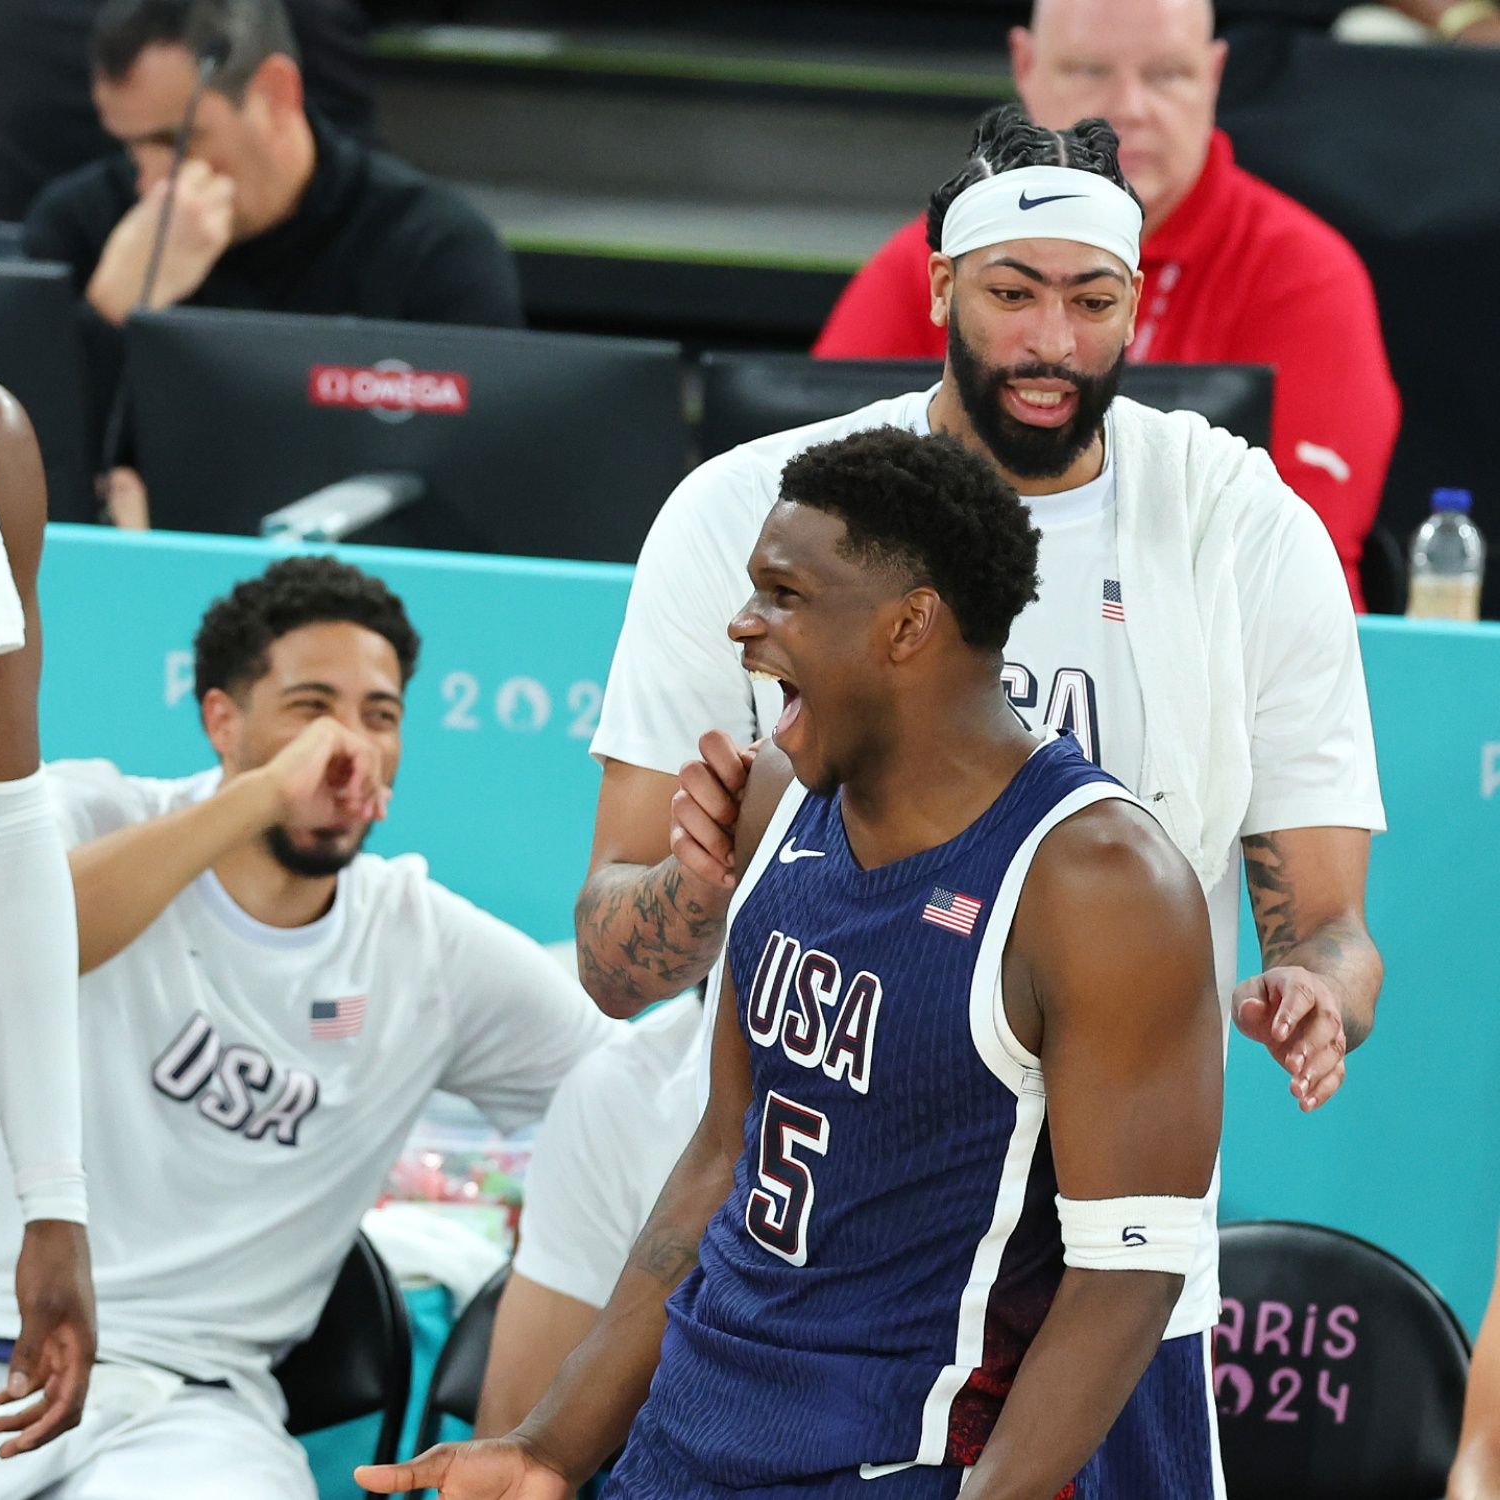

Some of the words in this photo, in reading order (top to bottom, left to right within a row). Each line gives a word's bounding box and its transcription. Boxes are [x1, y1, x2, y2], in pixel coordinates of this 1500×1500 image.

[151, 1010, 318, 1146] USA
[748, 930, 883, 1094] USA
[746, 1090, 830, 1267] 5
[1122, 1226, 1148, 1247] 5
